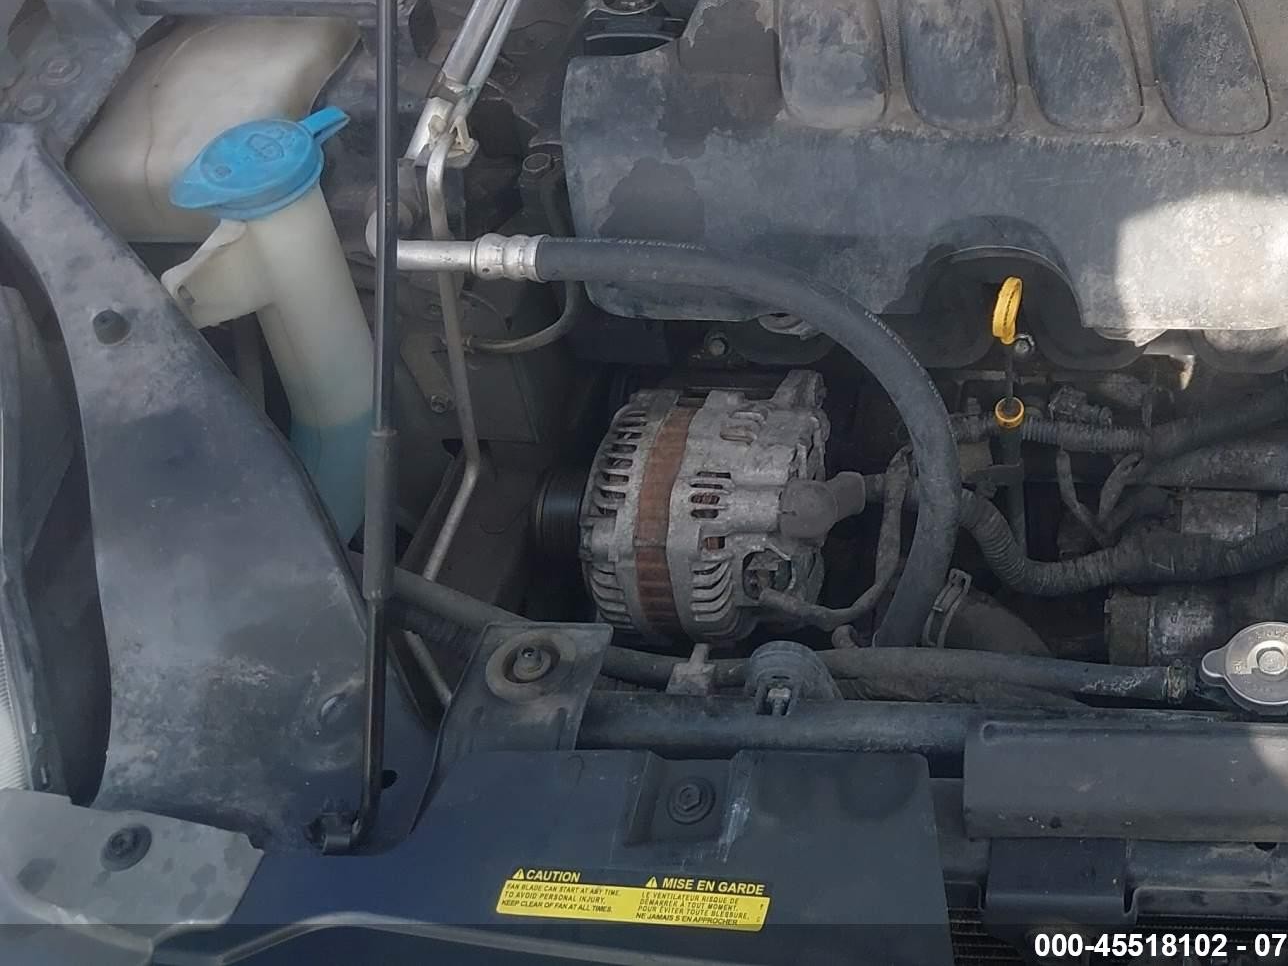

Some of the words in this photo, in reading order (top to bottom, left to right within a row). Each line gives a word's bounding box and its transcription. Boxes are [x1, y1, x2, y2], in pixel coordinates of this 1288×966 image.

[526, 869, 581, 883] CAUTION
[662, 878, 695, 890] MISE
[696, 880, 716, 891] EN
[718, 881, 765, 895] GARDE
[539, 893, 577, 902] PERSONAL
[652, 892, 700, 902] VENTILATEUR
[501, 899, 519, 907] KEEP
[687, 901, 706, 909] TOUT
[647, 913, 674, 921] JAMAIS
[693, 916, 738, 925] APPROCHER
